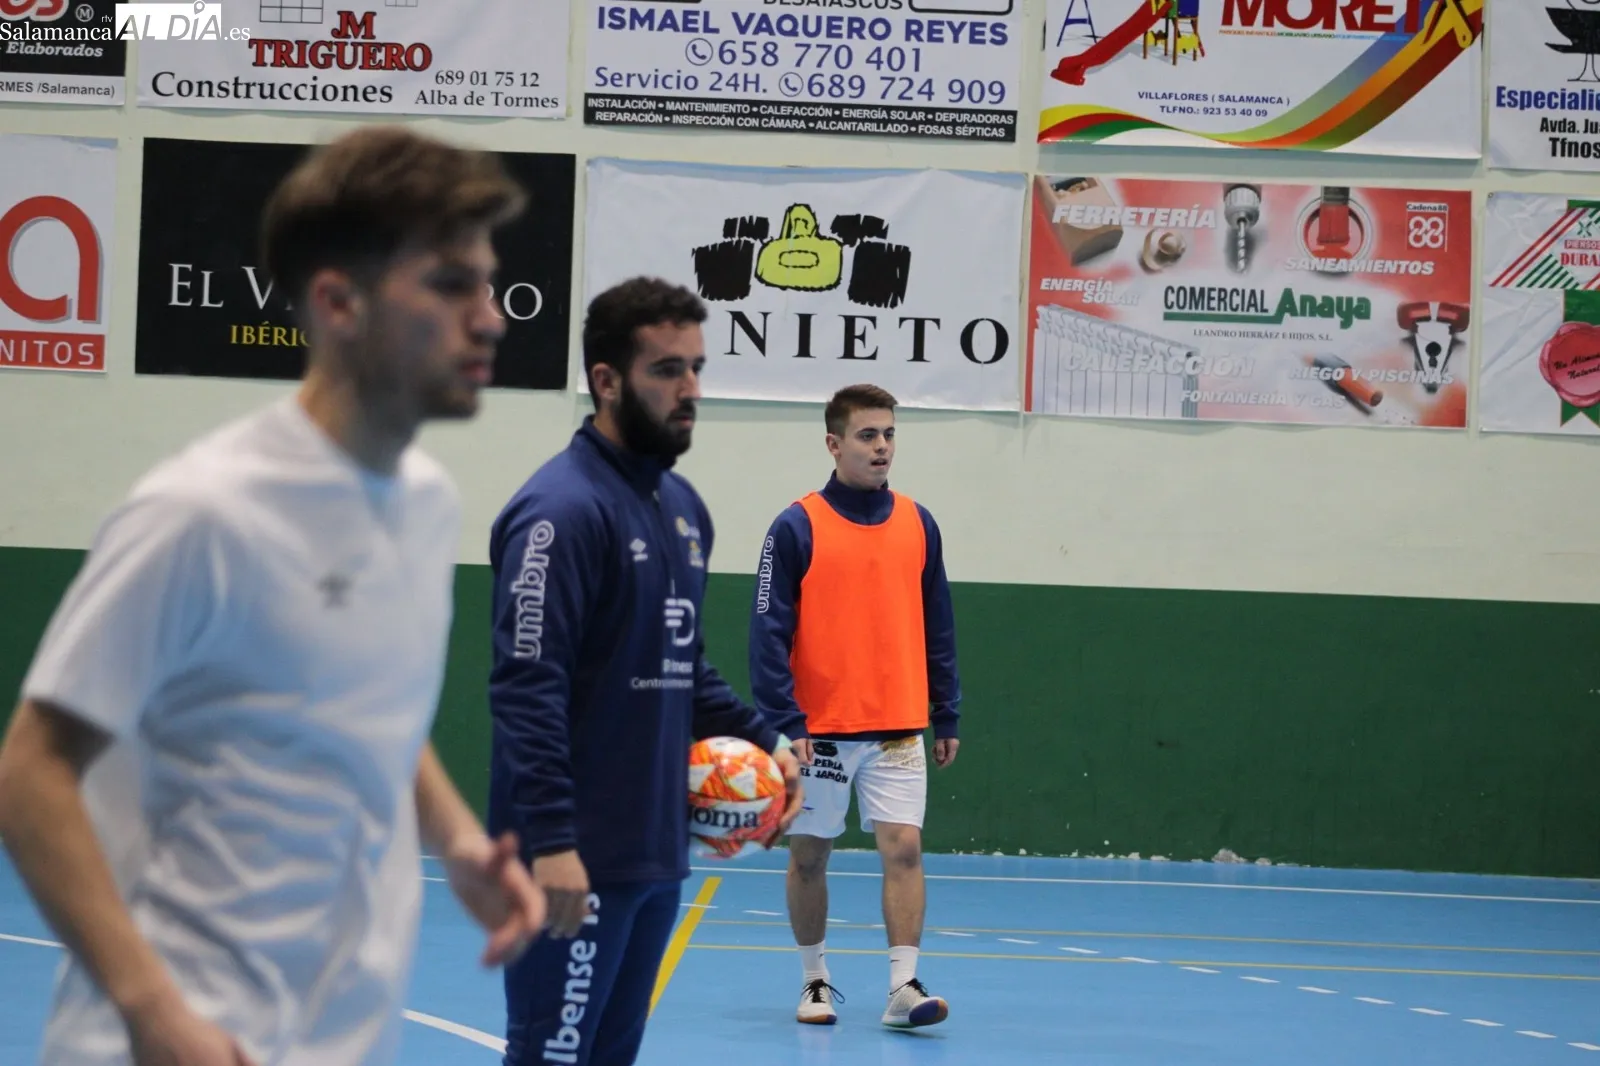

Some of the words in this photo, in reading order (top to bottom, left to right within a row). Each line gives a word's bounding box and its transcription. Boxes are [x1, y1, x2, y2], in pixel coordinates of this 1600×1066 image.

[598, 6, 720, 34] ISMAEL
[731, 12, 892, 41] VAQUERO
[904, 19, 1008, 46] REYES
[6, 41, 104, 57] Elaborados
[248, 38, 433, 71] TRIGUERO
[718, 40, 779, 67] 658
[794, 43, 853, 70] 770
[865, 46, 921, 73] 401
[152, 71, 393, 104] Construcciones
[435, 70, 464, 86] 689
[470, 72, 489, 87] 01
[495, 72, 514, 87] 75
[520, 73, 540, 88] 12
[595, 66, 699, 91] Servicio
[709, 71, 768, 94] 24H.
[807, 73, 866, 99] 689
[880, 76, 935, 101] 724
[948, 79, 1006, 105] 909
[415, 90, 457, 106] Alba
[463, 92, 485, 107] de
[491, 92, 559, 109] Tormes
[1138, 91, 1209, 102] VILLAFLORES
[1218, 94, 1284, 105] SALAMANCA
[587, 97, 656, 111] INSTALACIÓN
[665, 101, 750, 114] MANTENIMIENTO
[759, 104, 833, 118] CALEFACCIÓN
[842, 106, 887, 120] ENERGÍA
[890, 109, 926, 121] SOLAR
[935, 112, 1014, 125] DEPURADORAS
[1203, 107, 1221, 116] 923
[1224, 108, 1237, 117] 53
[1240, 108, 1252, 117] 40
[1255, 109, 1268, 118] 09
[595, 111, 663, 124] REPARACIÓN
[672, 114, 735, 127] INSPECCIÓN
[736, 117, 760, 128] CON
[761, 117, 806, 130] CÁMARA
[815, 121, 909, 134] ALCANTARILLADO
[918, 124, 954, 136] FOSAS
[955, 124, 1005, 138] SÉPTICAS
[1540, 117, 1580, 134] Avda.
[1583, 118, 1600, 134] Ju
[1051, 203, 1217, 229] FERRETERÍA
[1284, 256, 1436, 275] SANEAMIENTOS
[1561, 252, 1600, 267] DURA
[1039, 277, 1114, 292] ENERGÍA
[1164, 285, 1269, 315] COMERCIAL
[1278, 287, 1372, 330] Anaya
[723, 310, 1010, 365] NIETO
[1194, 329, 1237, 338] LEANDRO
[0, 338, 95, 366] NITOS
[1063, 347, 1256, 379] CALEFACCIÓN
[1290, 367, 1346, 381] RIEGO
[1368, 370, 1454, 385] PISCINAS
[757, 535, 774, 613] umbro
[510, 520, 555, 661] umbro
[814, 758, 844, 771] PERLA
[815, 770, 849, 784] JAMÓN
[690, 806, 757, 829] oma
